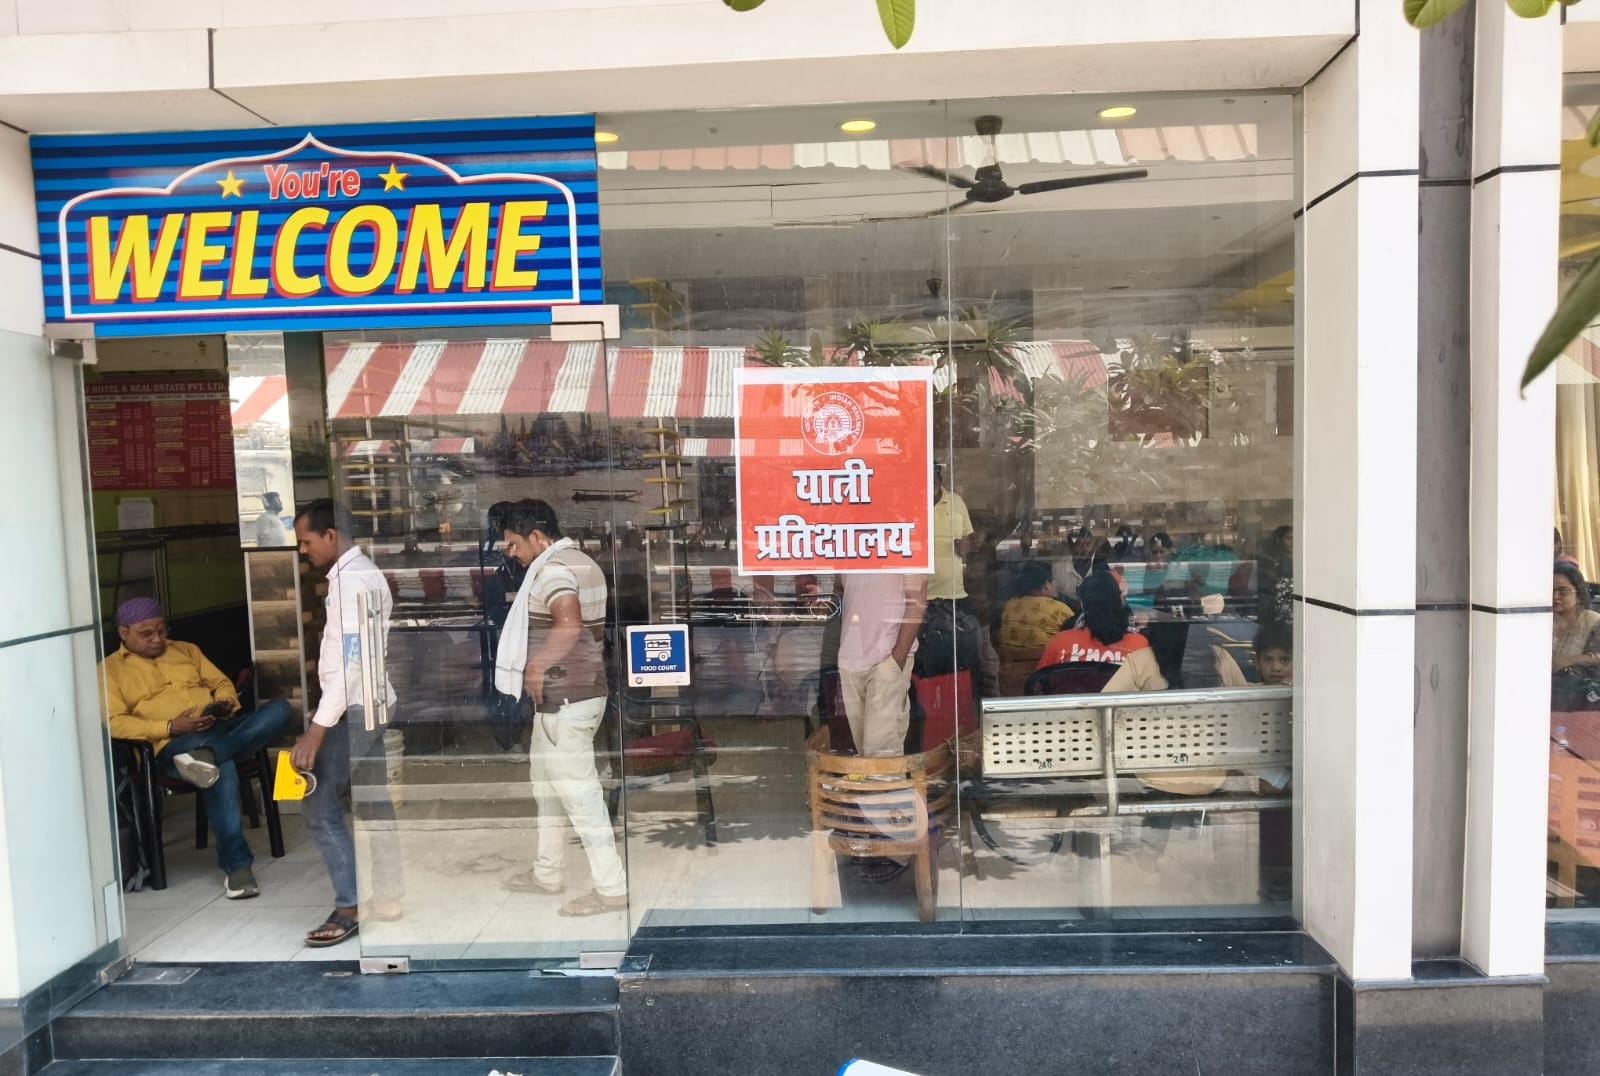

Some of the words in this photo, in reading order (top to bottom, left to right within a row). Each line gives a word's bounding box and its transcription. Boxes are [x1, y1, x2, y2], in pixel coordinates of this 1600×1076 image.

[263, 163, 361, 199] You're
[88, 201, 548, 303] WELCOME
[92, 384, 120, 393] HOTEL
[129, 383, 152, 393] REAL
[153, 382, 186, 392] ESTATE
[829, 394, 853, 407] INDIAN
[792, 458, 874, 505] यात्री
[754, 514, 916, 560] प्रतिक्षालय
